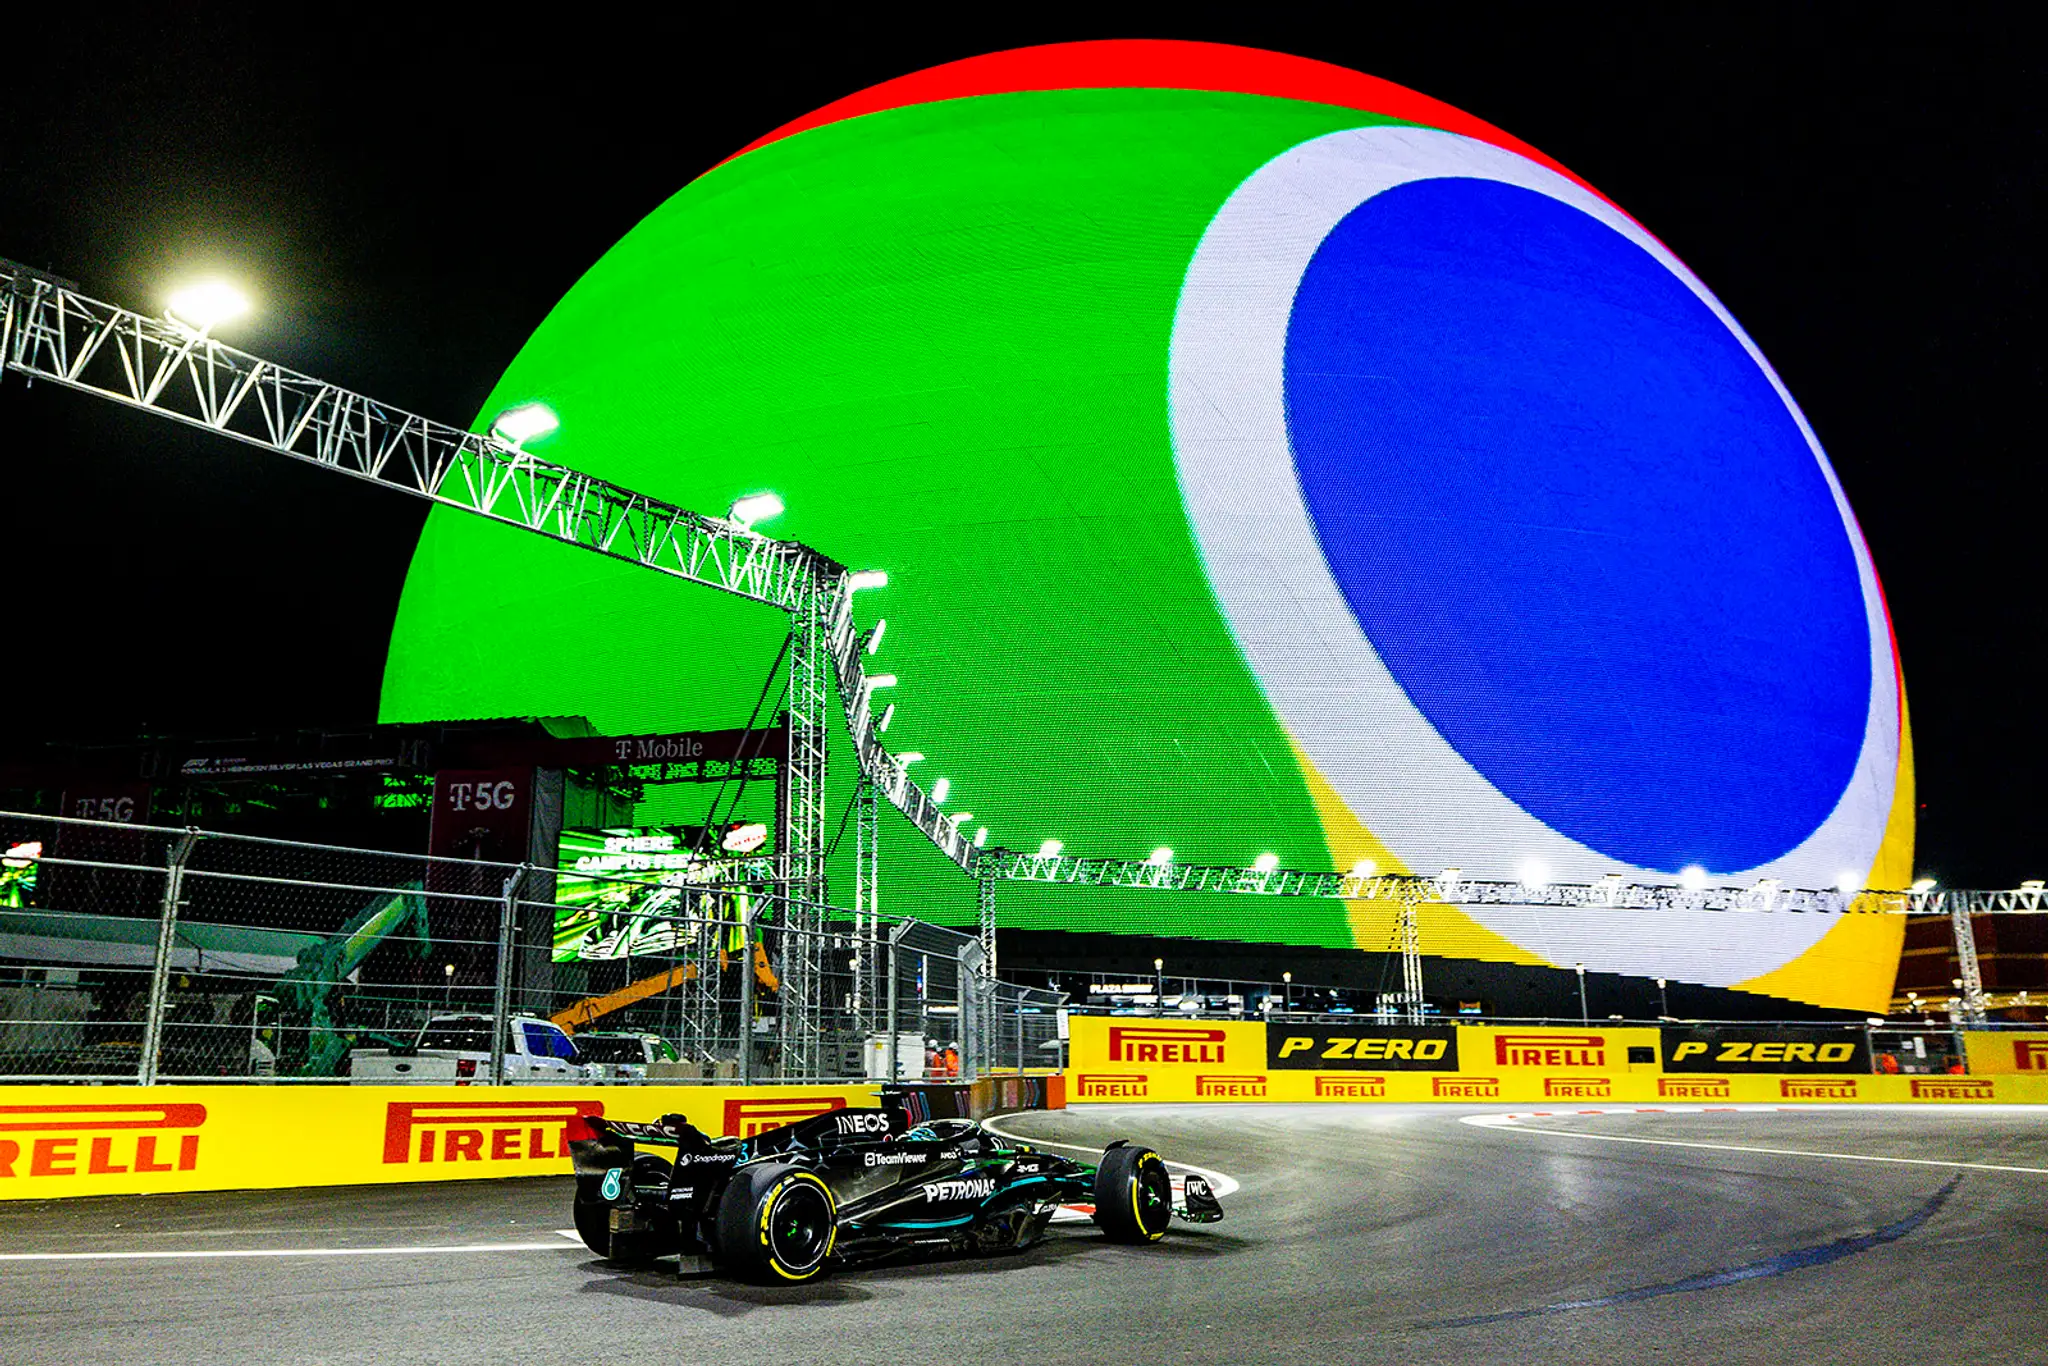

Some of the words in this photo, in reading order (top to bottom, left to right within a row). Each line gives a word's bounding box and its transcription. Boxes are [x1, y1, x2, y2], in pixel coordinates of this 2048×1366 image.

[637, 737, 703, 759] Mobile
[474, 781, 515, 810] 5G
[604, 836, 674, 851] SPHERE
[575, 855, 652, 871] CAMPUS
[1090, 984, 1123, 994] PLAZA
[1109, 1027, 1226, 1062] PIRELLI
[1278, 1038, 1313, 1058] P
[1321, 1039, 1448, 1060] ZERO
[1495, 1035, 1605, 1066] PIRELLI
[1672, 1042, 1708, 1062] P
[1715, 1043, 1856, 1063] ZERO
[1078, 1074, 1147, 1097] PIRELLI
[1196, 1075, 1267, 1096] PIRELLI
[1315, 1076, 1385, 1097] PIRELLI
[1432, 1077, 1499, 1097] PIRELLI
[1544, 1078, 1610, 1097] PIRELLI
[1658, 1078, 1729, 1097] PIRELLI
[1780, 1079, 1856, 1098] PIRELLI
[1911, 1080, 1994, 1098] PIRELLI
[383, 1101, 605, 1163] PIREL
[835, 1111, 890, 1134] INEOS
[693, 1153, 736, 1163] Snapdragon
[876, 1152, 927, 1165] TeamViewer
[923, 1178, 996, 1203] PETRONAS
[1186, 1181, 1208, 1196] IWC
